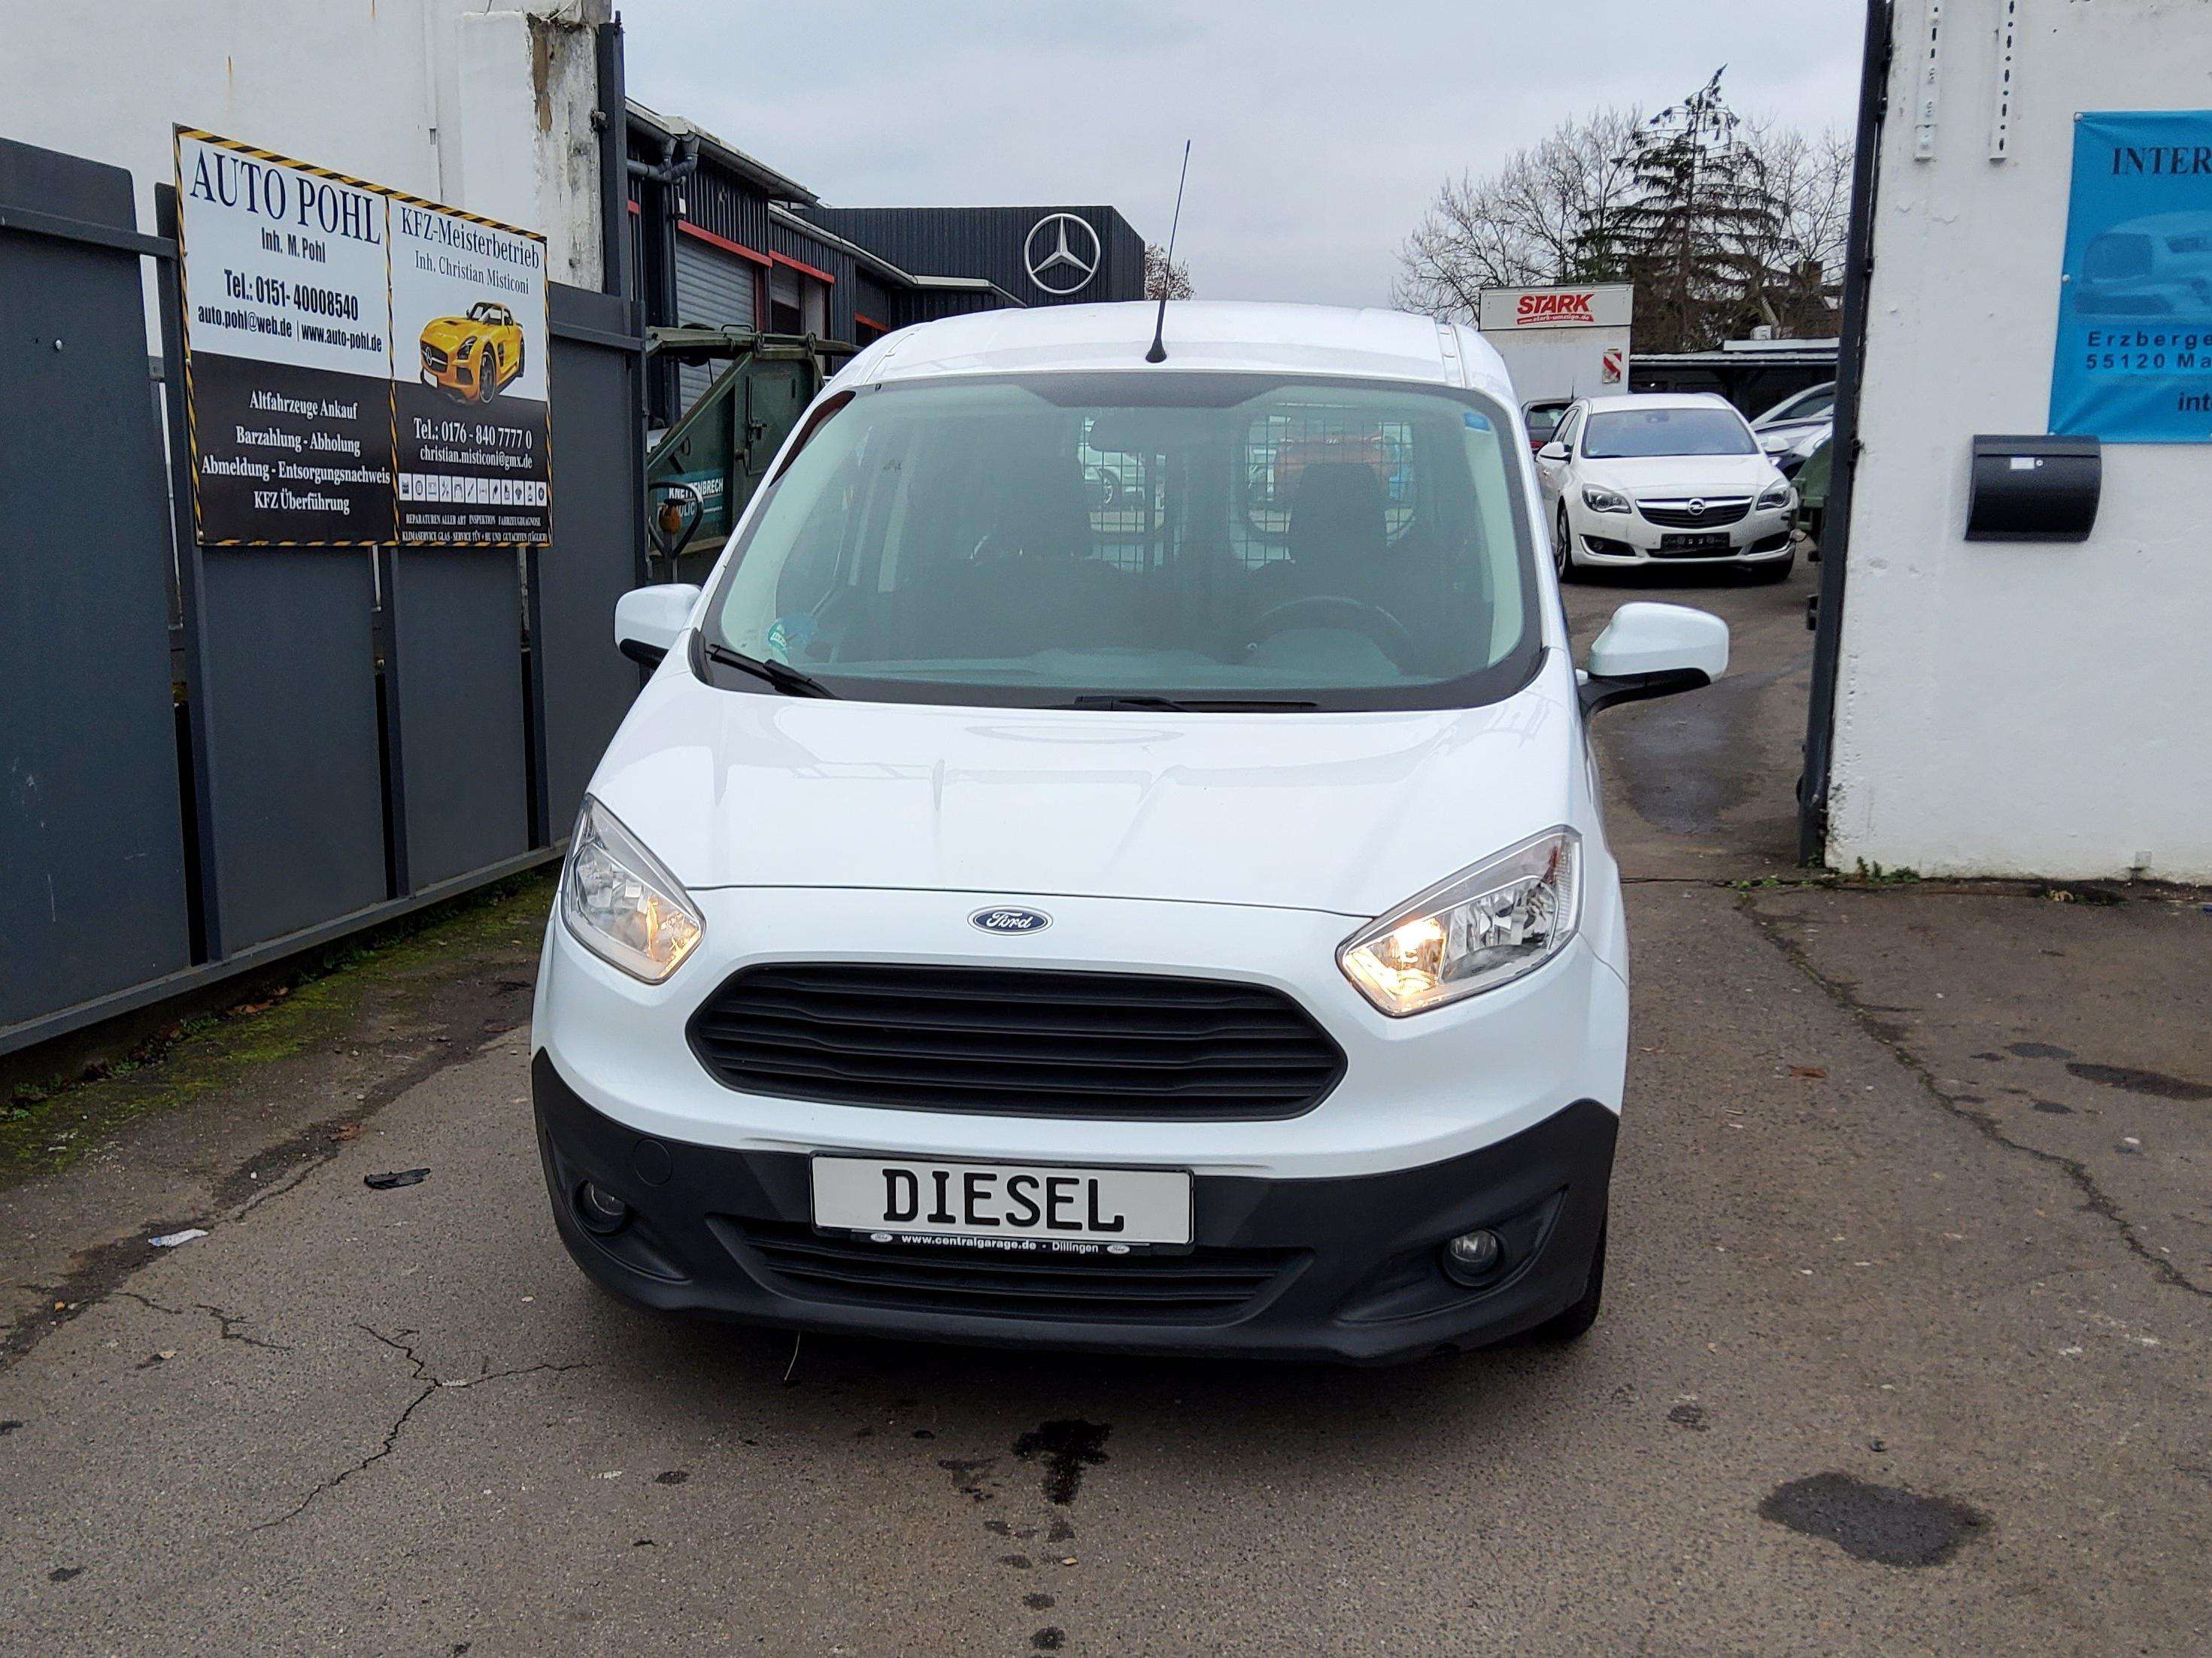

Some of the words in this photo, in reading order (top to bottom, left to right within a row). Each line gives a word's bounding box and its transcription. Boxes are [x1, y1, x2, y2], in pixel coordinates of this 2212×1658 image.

[2111, 146, 2212, 174] INTER
[190, 147, 286, 220] AUTO
[296, 177, 381, 244] POHL
[261, 226, 283, 253] Inh.
[287, 233, 299, 257] M.
[302, 237, 326, 263] Pohl
[401, 207, 539, 269] KFZ-Meisterbetrieb
[415, 250, 436, 273] Inh.
[438, 256, 484, 284] Christian
[487, 268, 529, 295] Misticoni
[224, 268, 253, 301] Tel.:
[293, 283, 359, 321] 40008540
[1517, 294, 1595, 315] STARK
[198, 305, 293, 338] auto.pohl@web.de
[2087, 331, 2212, 350] Erzberge
[2086, 353, 2166, 369] 55120
[2177, 353, 2212, 368] Ma
[249, 389, 319, 420] Altfahrzeuge
[320, 399, 358, 420] Ankauf
[235, 426, 302, 453] Barzahlung
[310, 432, 361, 457] Abholung
[414, 417, 438, 441] Tel.:
[441, 421, 466, 444] 0176
[476, 424, 496, 446] 840
[498, 427, 523, 449] 7777
[525, 430, 533, 450] 0
[202, 455, 270, 481] Abmeldung
[278, 460, 390, 485] Entsorgungsnachweis
[420, 444, 533, 471] christian.misticoni@gmx.de
[253, 490, 279, 509] KFZ
[281, 488, 350, 515] Überführung
[986, 911, 1033, 929] Ford
[882, 1168, 1124, 1232] DIESEL
[901, 1234, 1036, 1251] www.centralgarage.de
[1051, 1242, 1099, 1254] Dillingen
